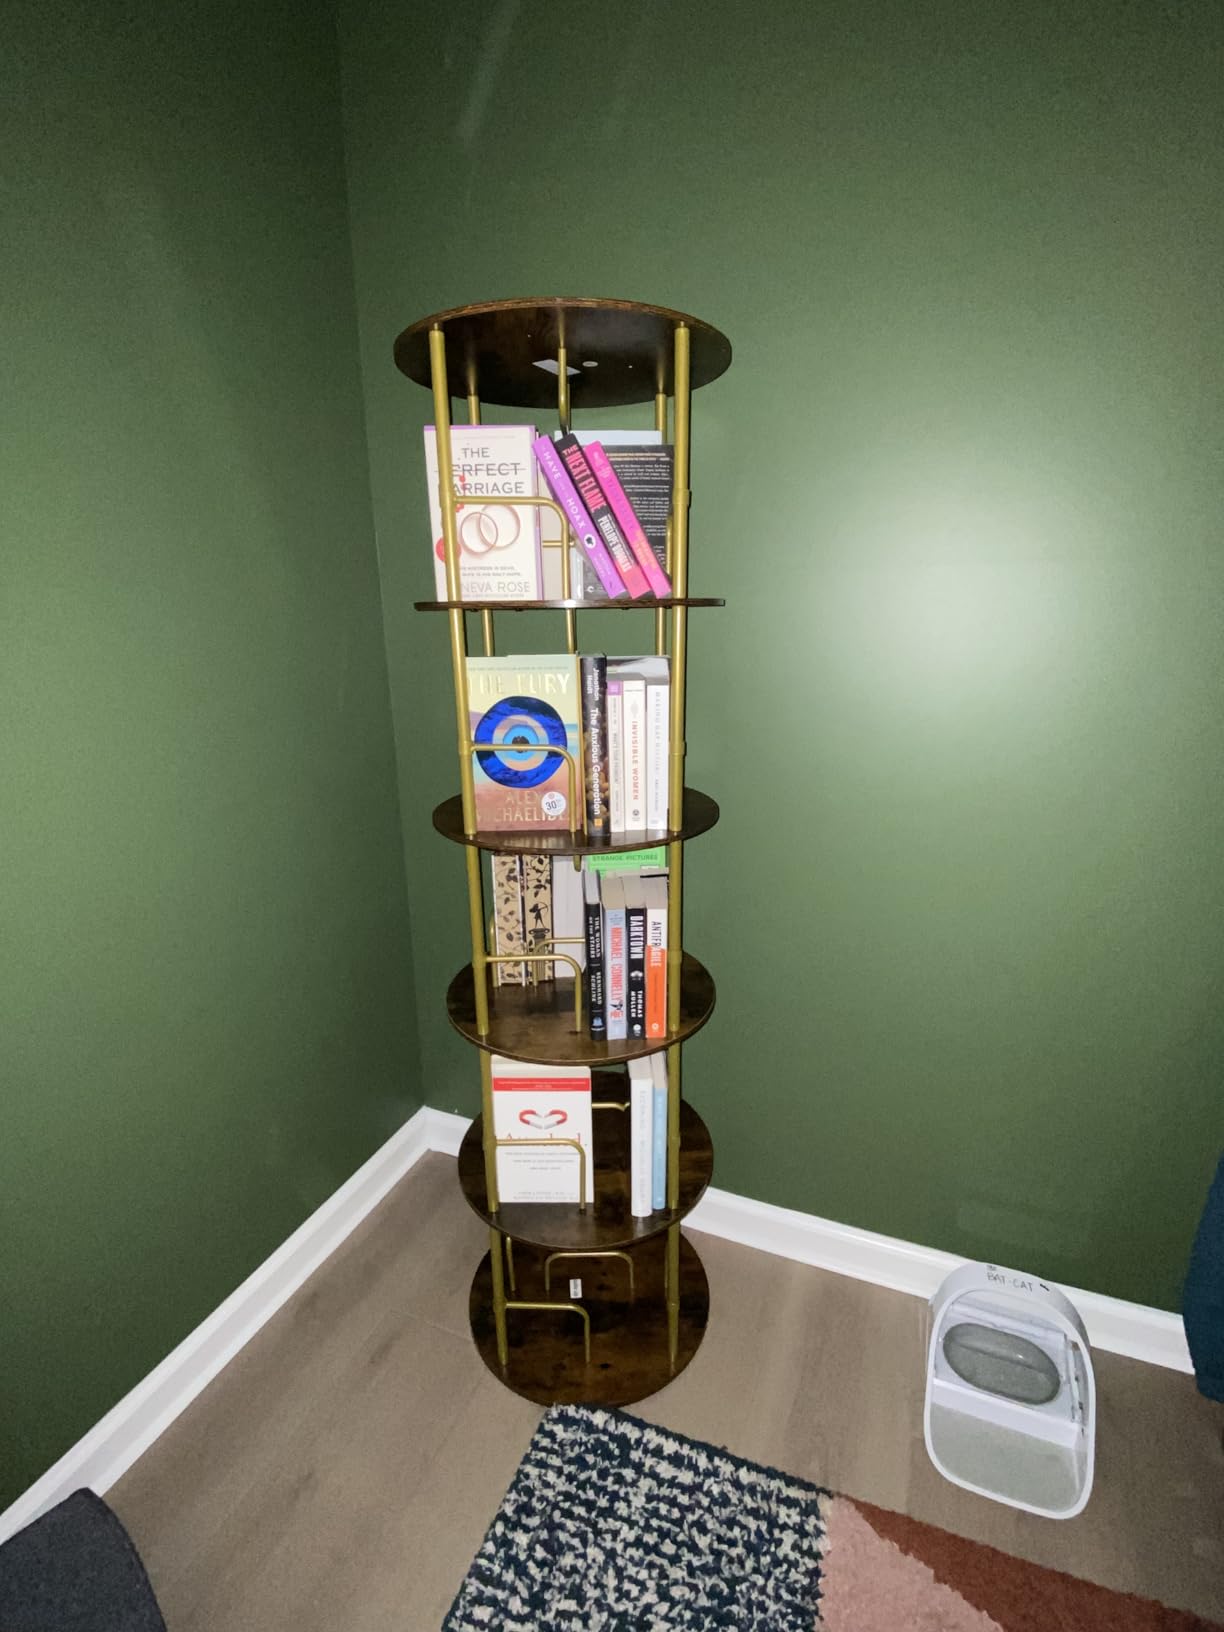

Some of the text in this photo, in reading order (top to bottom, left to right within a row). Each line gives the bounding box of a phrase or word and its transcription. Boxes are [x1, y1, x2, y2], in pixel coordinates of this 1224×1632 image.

[452, 462, 521, 476] ERFECT
[461, 447, 490, 458] THE
[453, 481, 525, 495] ARRIAGE
[543, 451, 587, 529] HAVE HOAX
[565, 451, 591, 480] NEXT
[579, 477, 607, 513] FLAME
[462, 581, 531, 593] NEVA ROSE
[592, 667, 600, 701] Jonathan
[590, 707, 602, 815] The Anxious Generation
[631, 720, 639, 764] INVISIBLE
[611, 927, 623, 961] MICHAEL
[630, 915, 644, 959] DARKTOWN
[651, 921, 662, 968] ANTIFRAGILE
[611, 963, 623, 1001] CONNELLY
